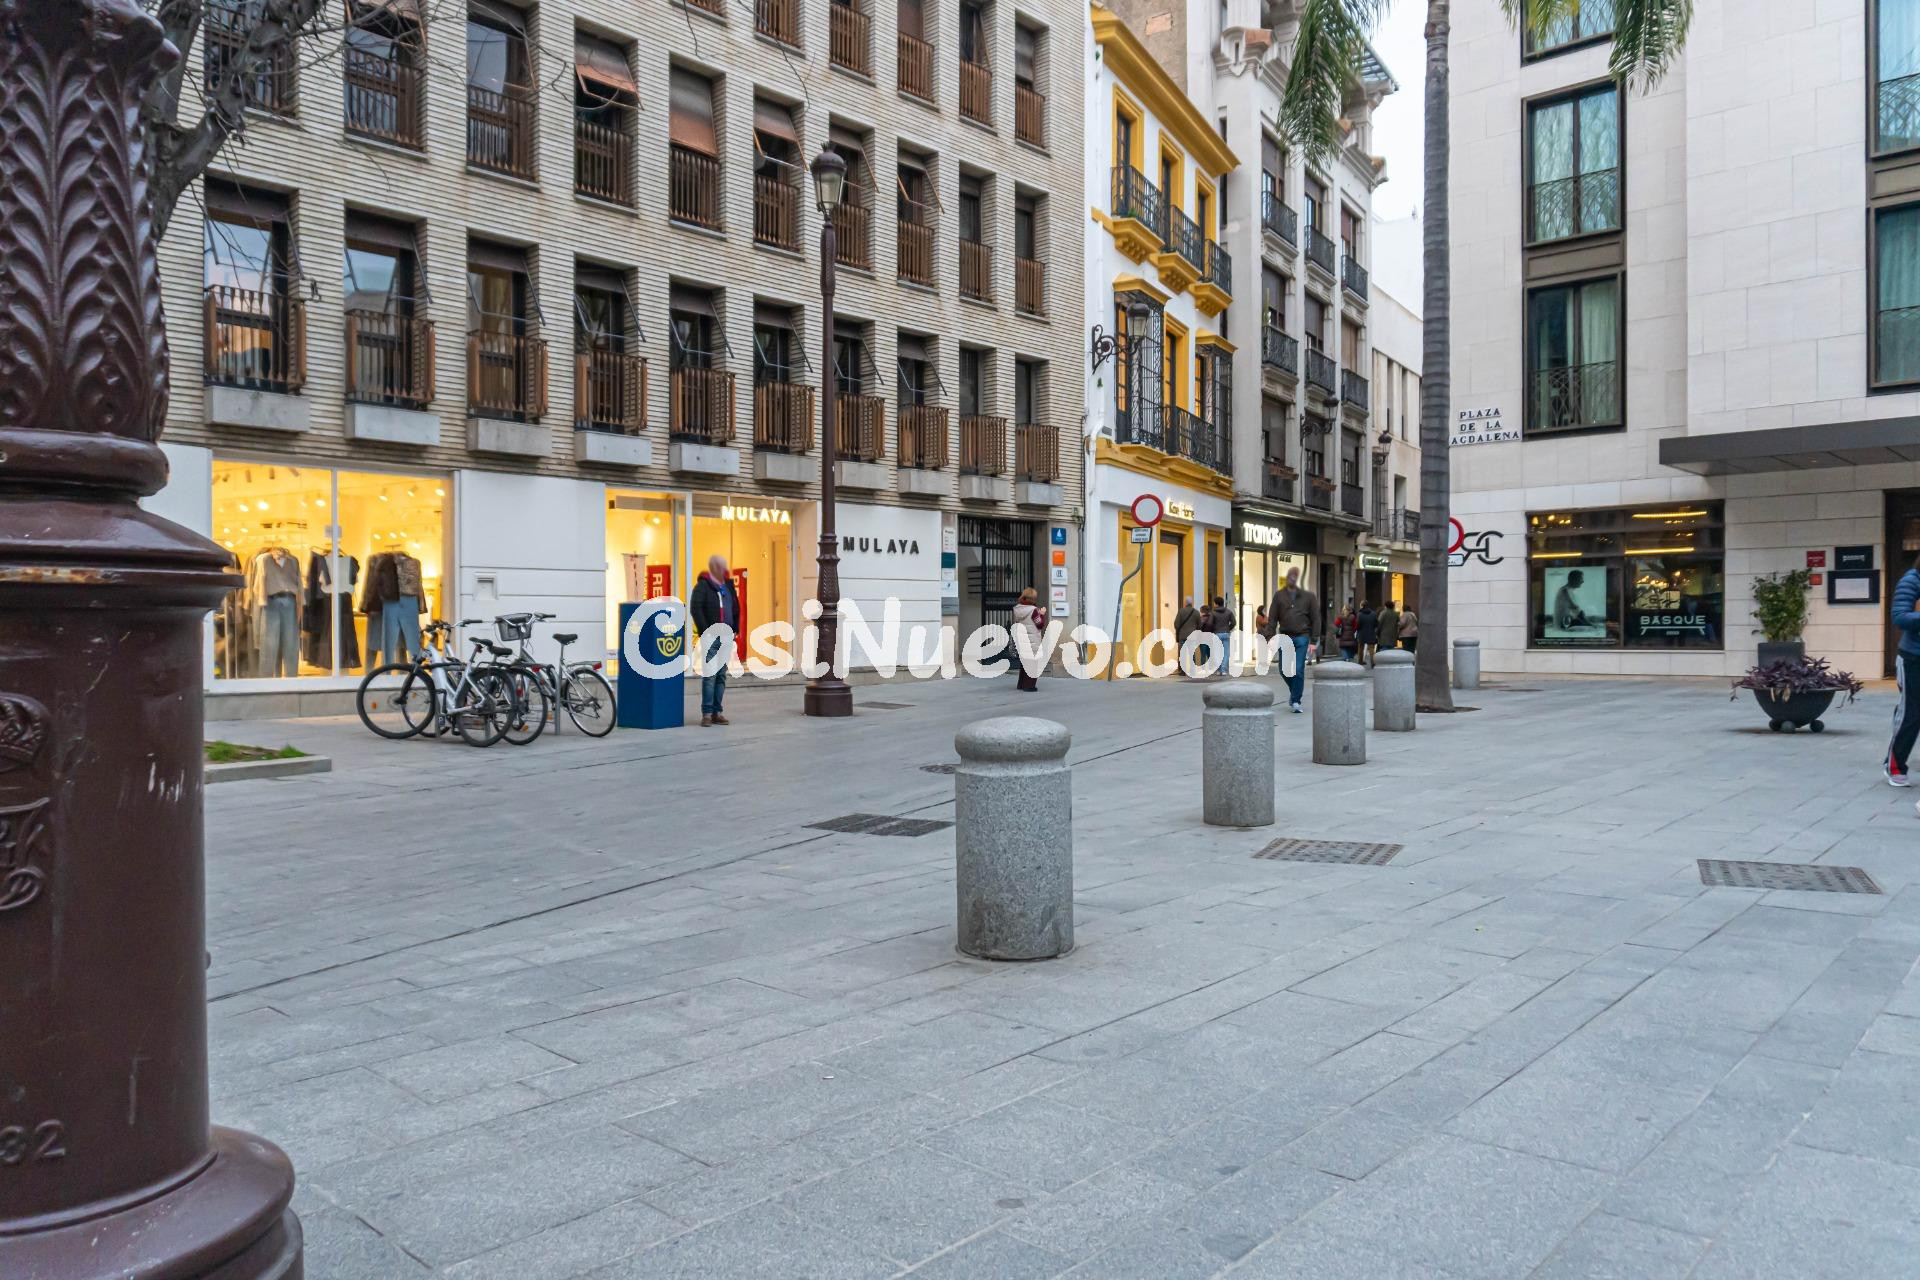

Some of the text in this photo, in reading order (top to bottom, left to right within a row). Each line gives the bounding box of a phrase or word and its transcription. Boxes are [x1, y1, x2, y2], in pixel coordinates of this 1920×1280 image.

[1459, 407, 1501, 420] PLAZA
[1459, 420, 1502, 432] DE LA
[1451, 430, 1520, 446] AGDALENA
[721, 504, 791, 526] MULAYA
[842, 536, 920, 555] MULAYA
